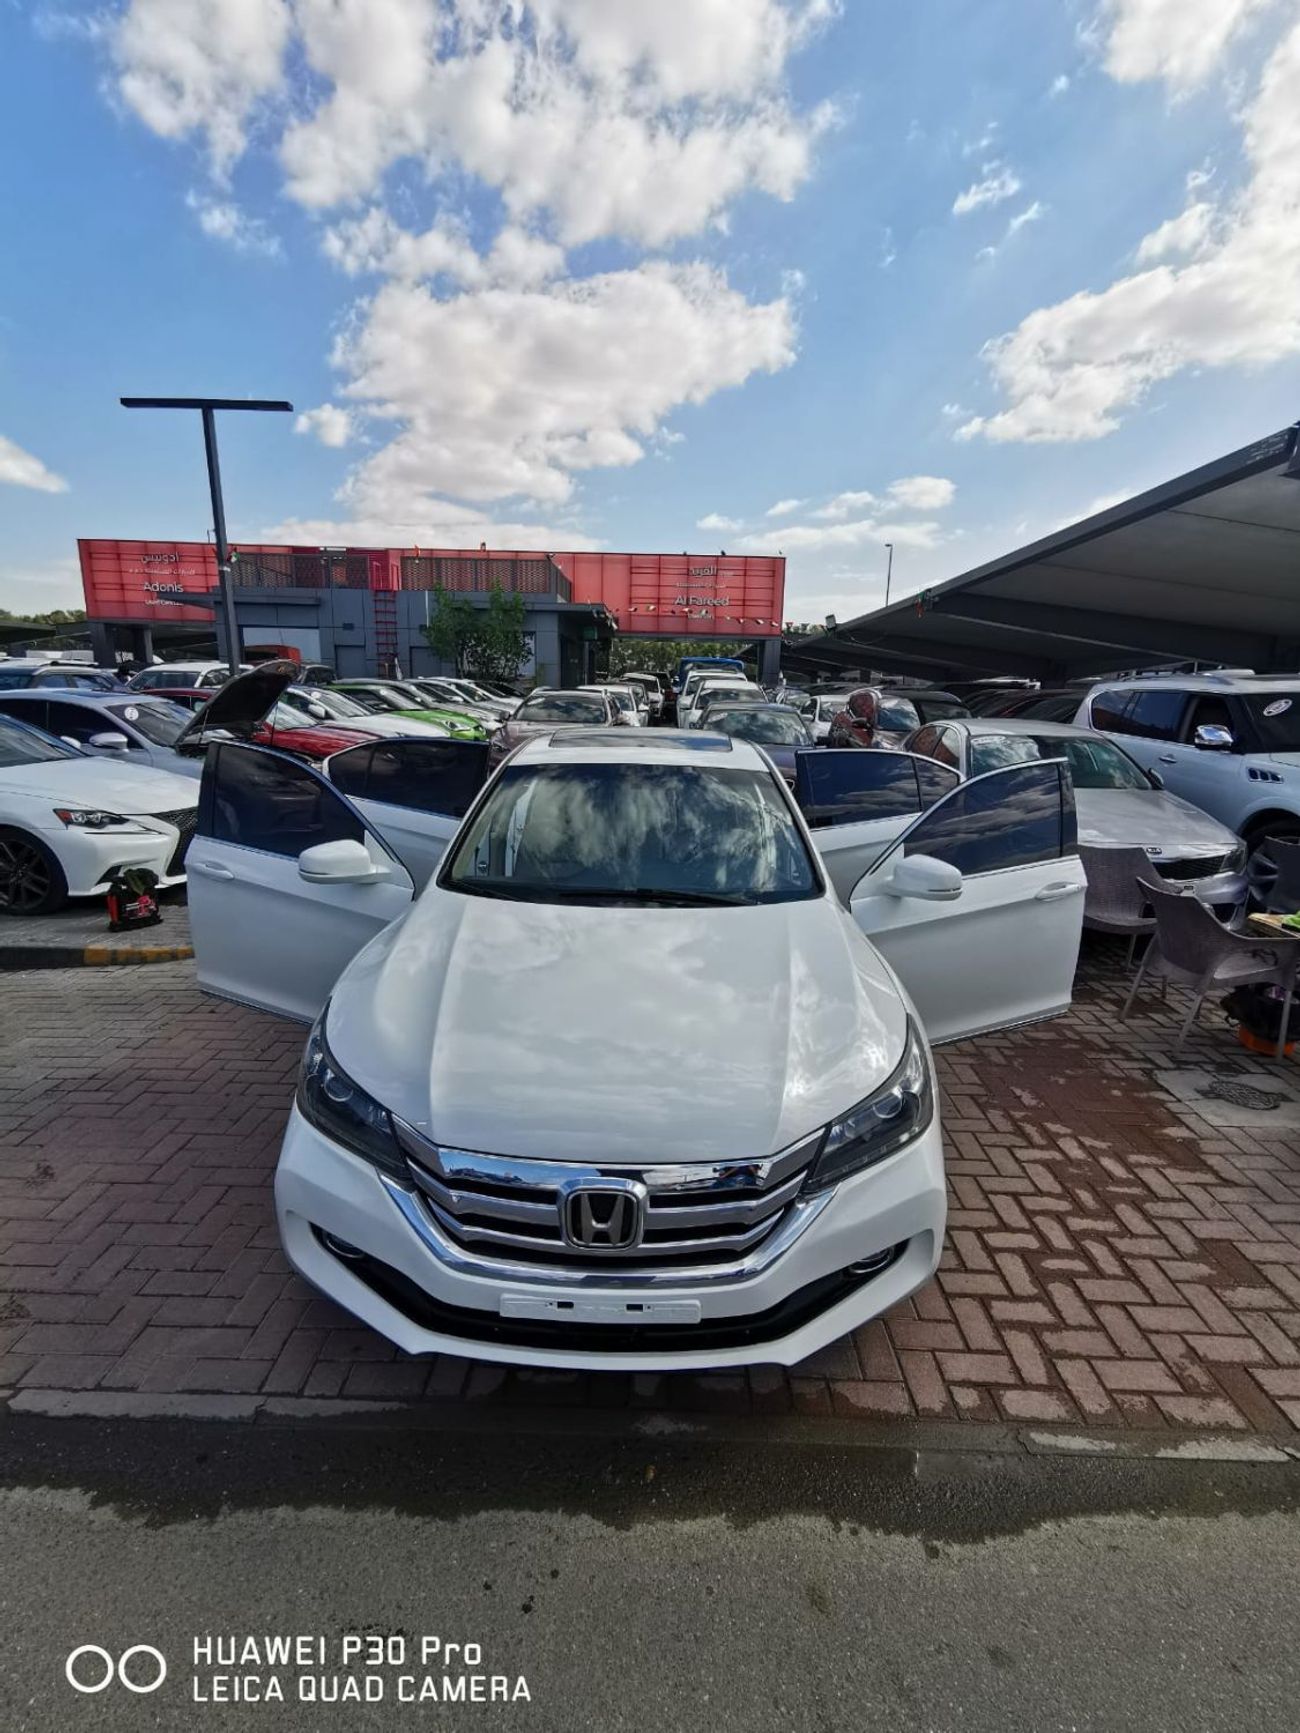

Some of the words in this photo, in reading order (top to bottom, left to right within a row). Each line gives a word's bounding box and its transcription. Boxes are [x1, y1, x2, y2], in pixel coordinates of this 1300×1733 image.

[144, 581, 184, 592] Adonis
[675, 595, 687, 605] Al
[689, 595, 729, 605] Fareed
